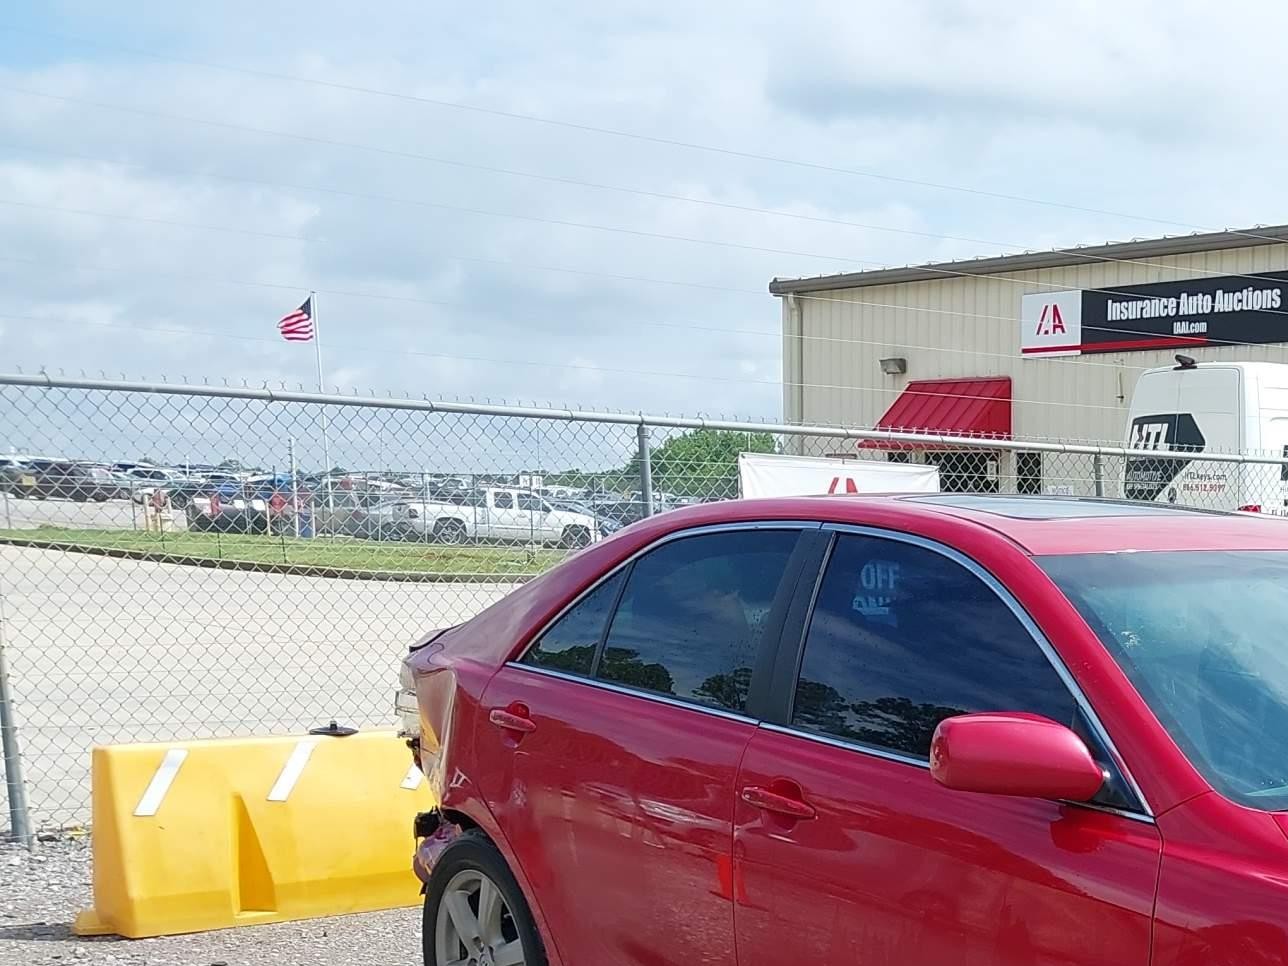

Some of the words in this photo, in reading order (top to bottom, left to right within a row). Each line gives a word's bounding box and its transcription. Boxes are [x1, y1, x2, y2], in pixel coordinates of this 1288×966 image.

[1107, 297, 1177, 321] Insurance
[1178, 293, 1212, 315] Auto
[1213, 287, 1281, 312] Auctions
[1173, 321, 1207, 334] IAAI.com
